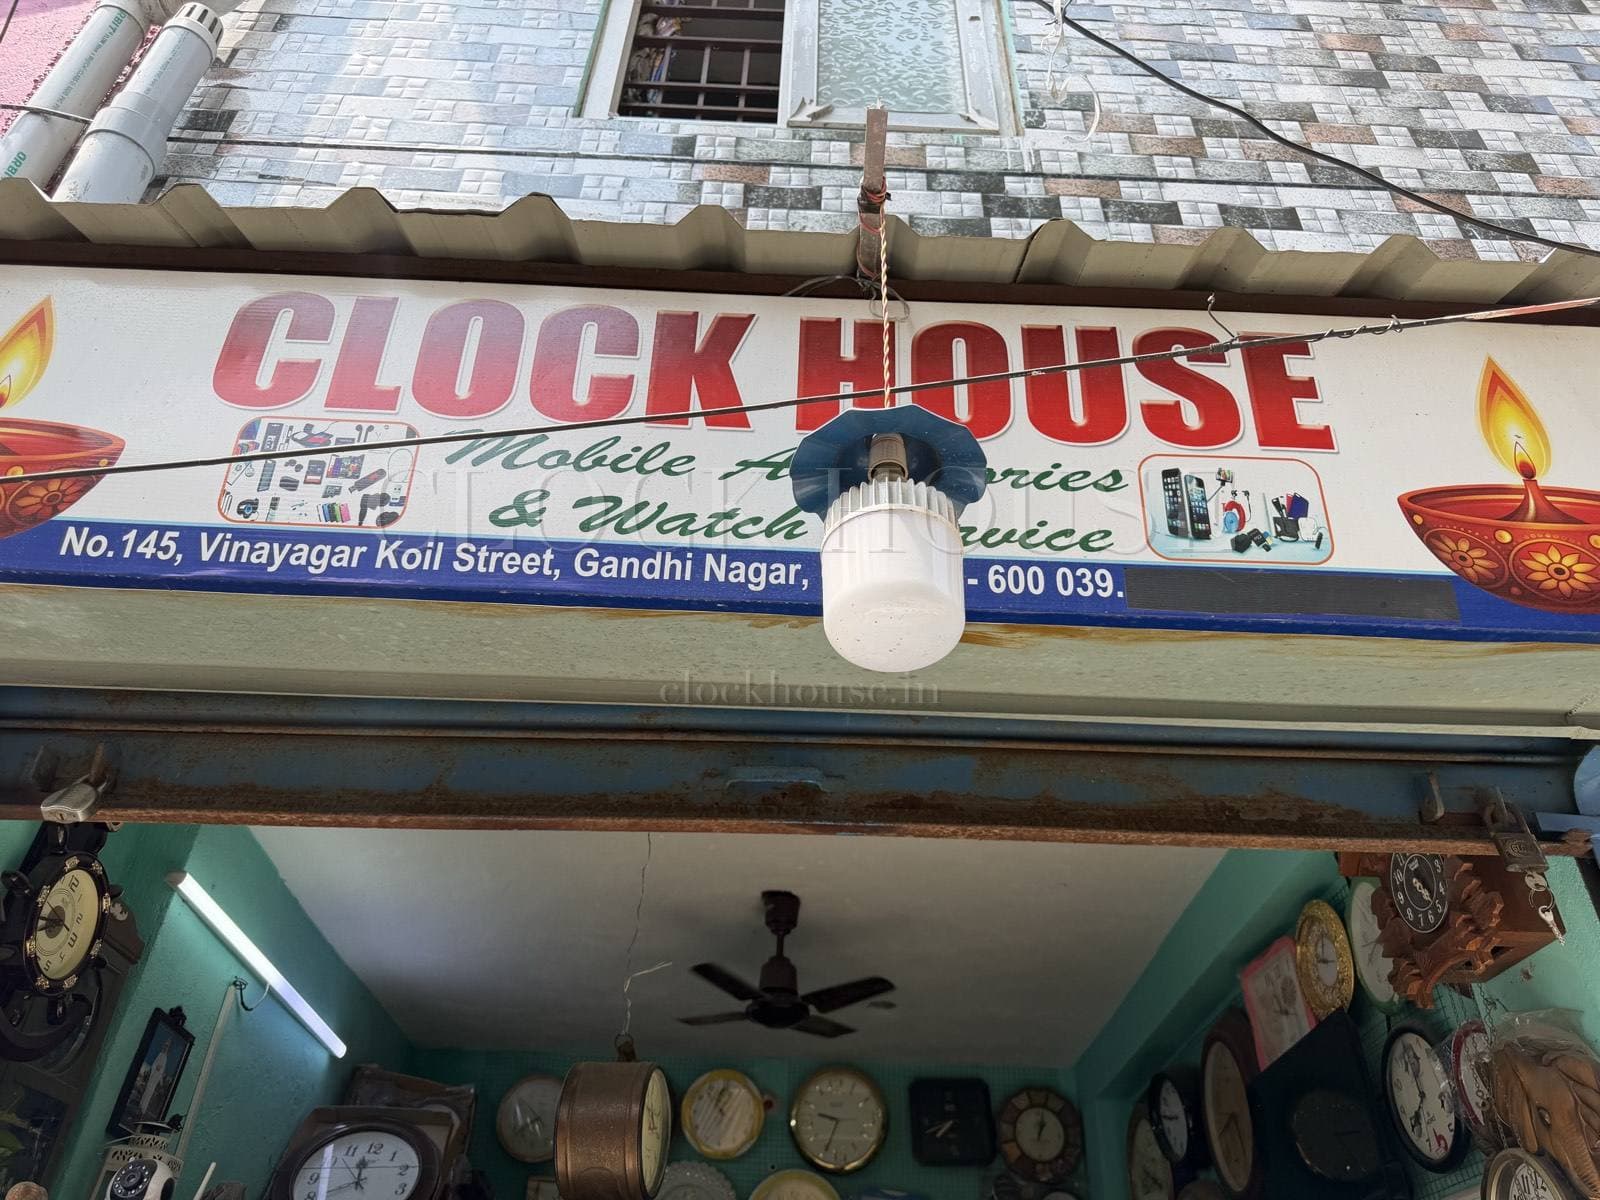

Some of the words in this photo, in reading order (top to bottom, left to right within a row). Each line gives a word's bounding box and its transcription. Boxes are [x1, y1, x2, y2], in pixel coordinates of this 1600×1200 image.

[4, 151, 27, 178] ORBI
[211, 291, 757, 430] CLOCK
[795, 317, 1338, 451] HOUSE
[445, 428, 697, 476] Mobile
[488, 489, 551, 528] &
[572, 495, 809, 540] Watch
[959, 520, 1114, 552] rvice
[200, 531, 367, 574] Vinayagar
[374, 539, 444, 571] Koil
[452, 542, 561, 580] Street,
[573, 547, 693, 580] Gandhi
[704, 553, 809, 590] Nagar,
[988, 564, 1045, 595] 600
[1055, 567, 1124, 598] 039.
[1434, 859, 1441, 873] 3
[1393, 868, 1403, 885] 10
[1397, 891, 1405, 905] 9
[1435, 899, 1442, 913] 5
[1406, 907, 1414, 921] 8
[1427, 910, 1435, 924] 6
[344, 1144, 359, 1157] 11
[367, 1142, 384, 1155] 12
[390, 1150, 398, 1162] 1
[306, 1172, 320, 1185] 9
[394, 1182, 408, 1196] 3
